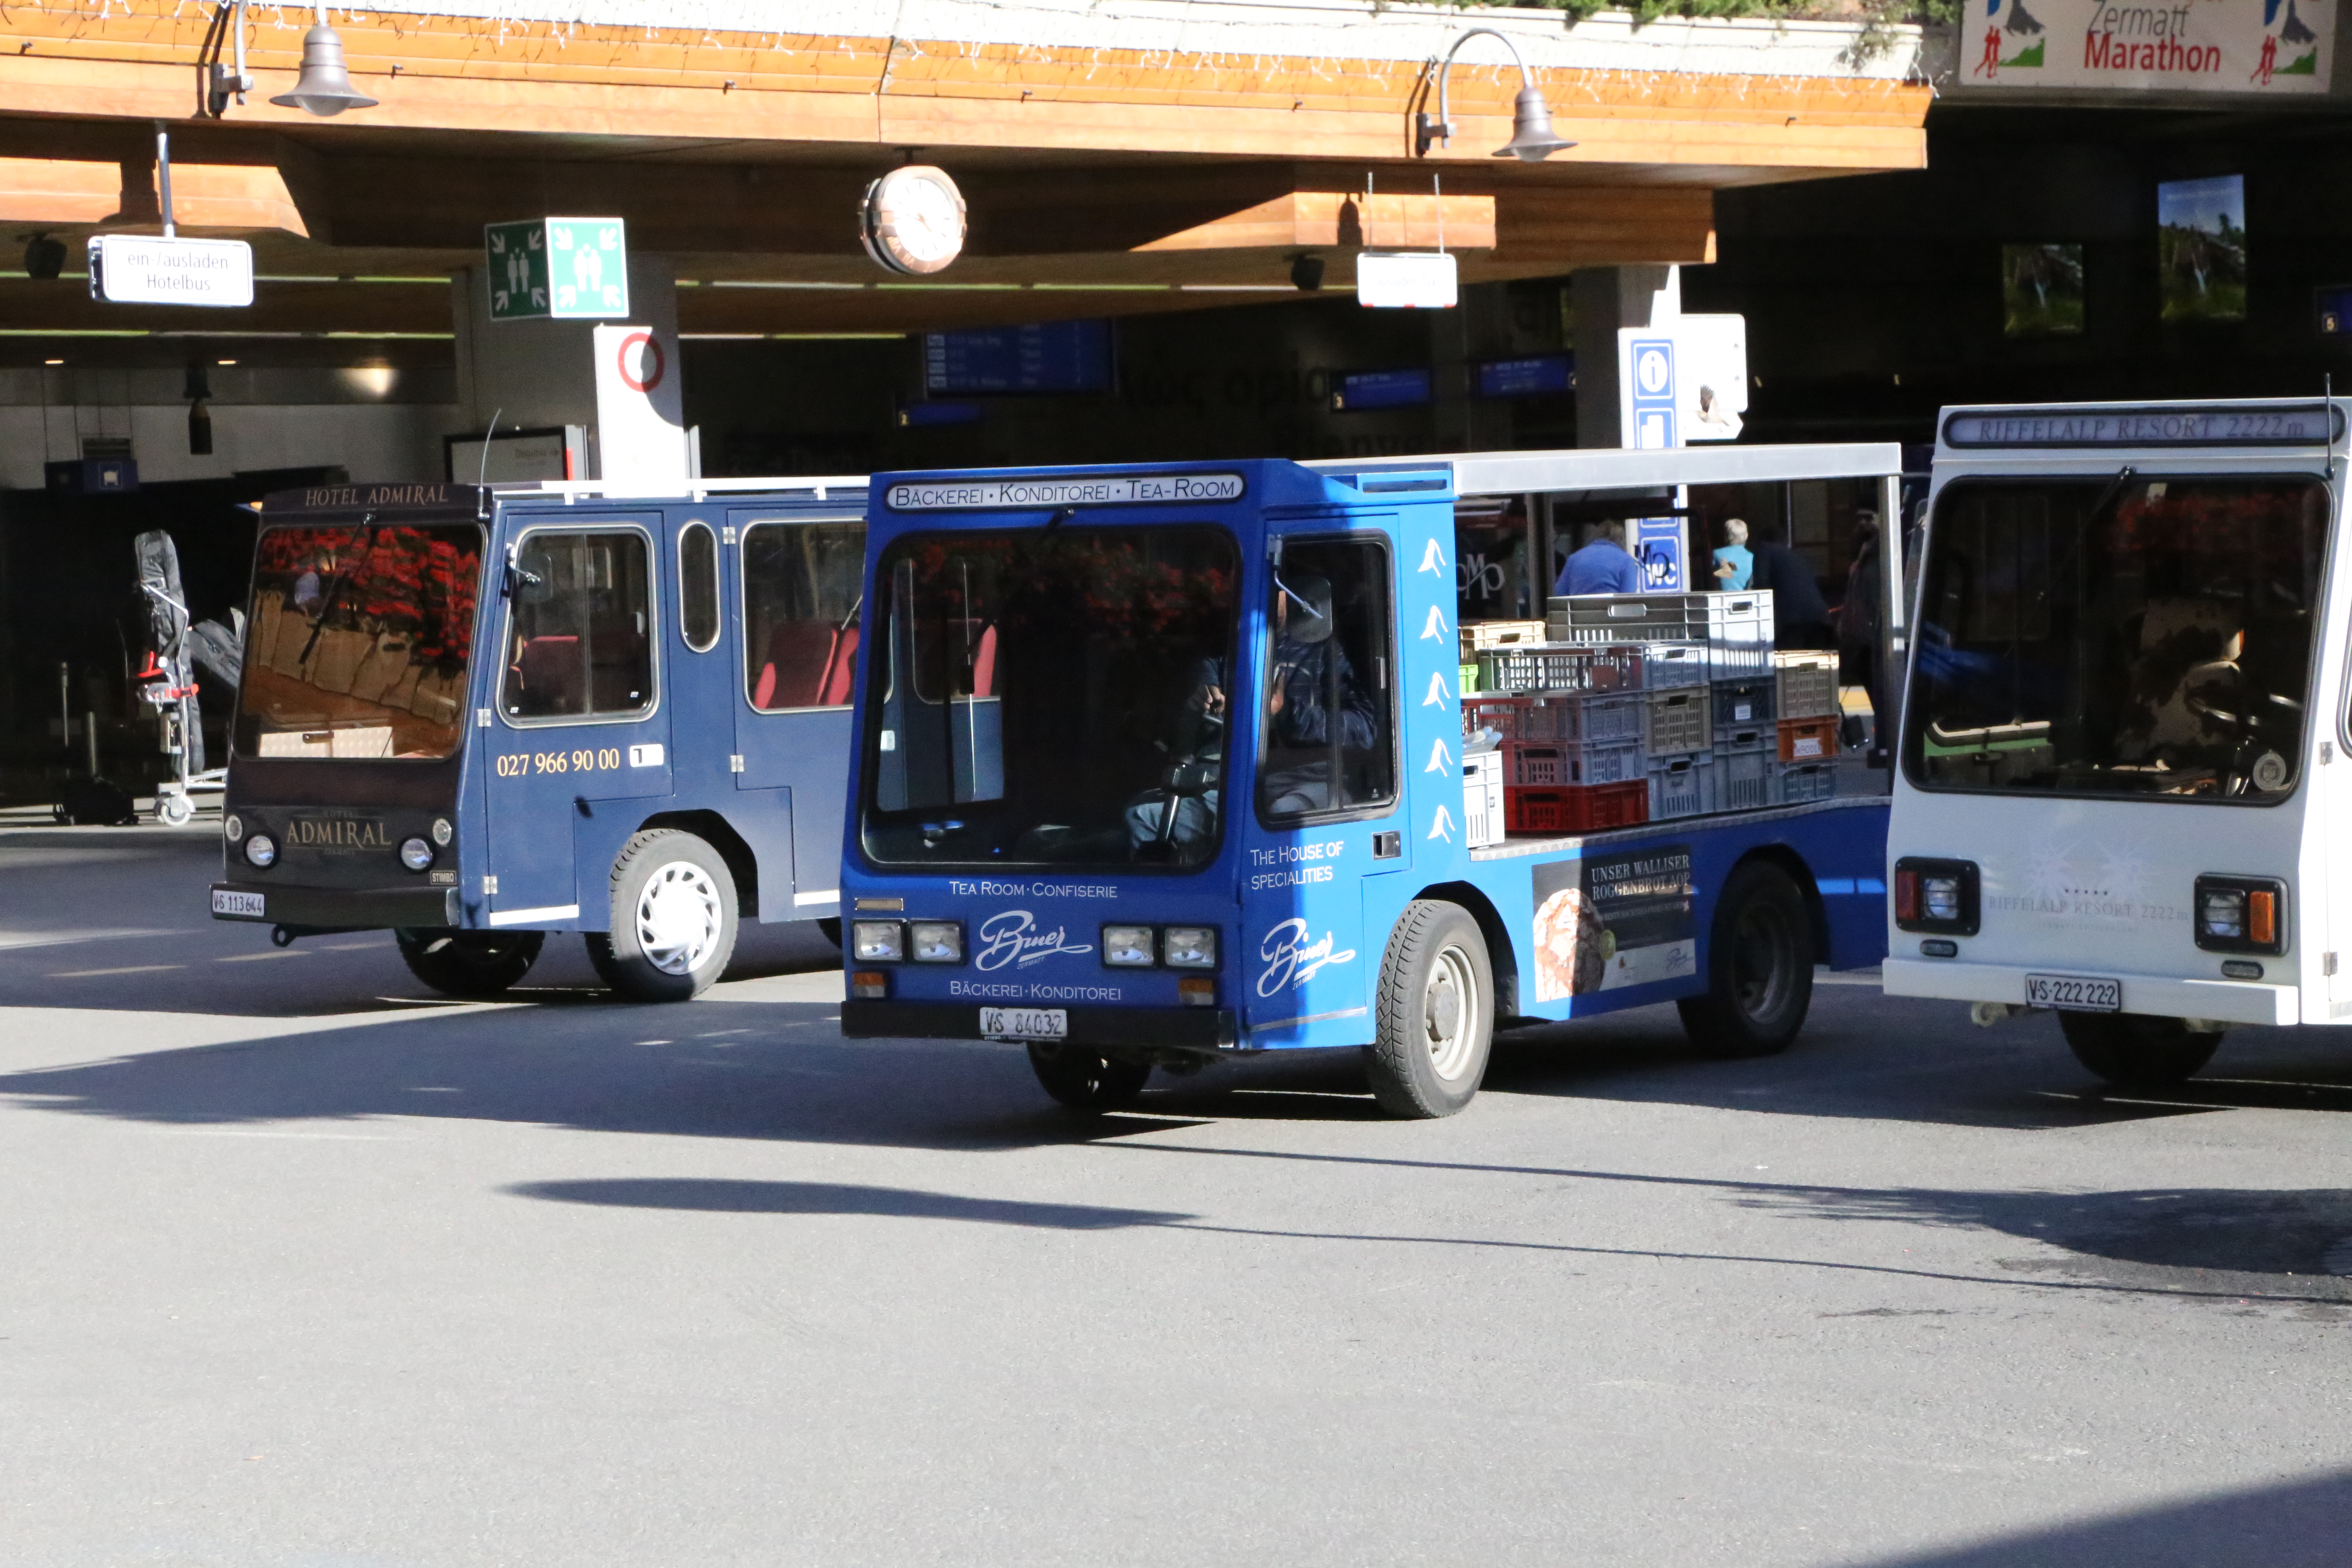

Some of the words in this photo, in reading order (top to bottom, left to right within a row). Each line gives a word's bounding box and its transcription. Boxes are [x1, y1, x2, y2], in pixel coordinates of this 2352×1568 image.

[2088, 0, 2189, 37] Zermatt
[2084, 33, 2221, 72] Marathon
[128, 251, 228, 269] ein-/ausladen
[147, 274, 210, 291] Hotelbus
[1980, 420, 2106, 441] RIFFELALP
[2117, 415, 2216, 439] RESORT
[306, 488, 358, 506] HOTEL
[368, 485, 448, 505] ADMIRAL
[896, 487, 984, 506] BÄCKEREI
[1000, 480, 1109, 503] KONDITOREI
[1127, 478, 1234, 499] TEA-ROOM
[1646, 563, 1676, 585] WC
[497, 754, 529, 776] 027
[535, 752, 567, 774] 966
[572, 750, 593, 771] 90
[598, 748, 619, 769] 00
[286, 821, 392, 849] ADMIRAL
[1250, 849, 1275, 866] THE
[1279, 843, 1324, 863] HOUSE
[1326, 841, 1344, 858] OF
[432, 872, 454, 882] STIMBO
[1251, 866, 1332, 890] SPECIALITIES
[1592, 864, 1630, 882] UNSER
[1634, 855, 1690, 876] WALLISER
[949, 881, 977, 895] TEA
[981, 881, 1025, 896] ROOM
[1032, 882, 1118, 898] CONFISERIE
[1592, 875, 1666, 900] ROGGENBROT
[1669, 872, 1690, 888] AOP
[213, 894, 224, 909] VS
[229, 895, 262, 912] 113644
[1989, 896, 2067, 913] RIFFELALP
[2075, 901, 2132, 917] RESORT
[976, 910, 1093, 971] Biner
[1017, 956, 1044, 969] ZERMATT
[1257, 918, 1355, 998] Biner
[950, 981, 1023, 997] BÄCKEREI
[1031, 983, 1121, 1001] KONDITOREI
[1292, 970, 1316, 989] ZERMATT
[2029, 980, 2048, 1000] VS
[986, 1011, 1004, 1032] VS
[1015, 1013, 1062, 1034] 84032
